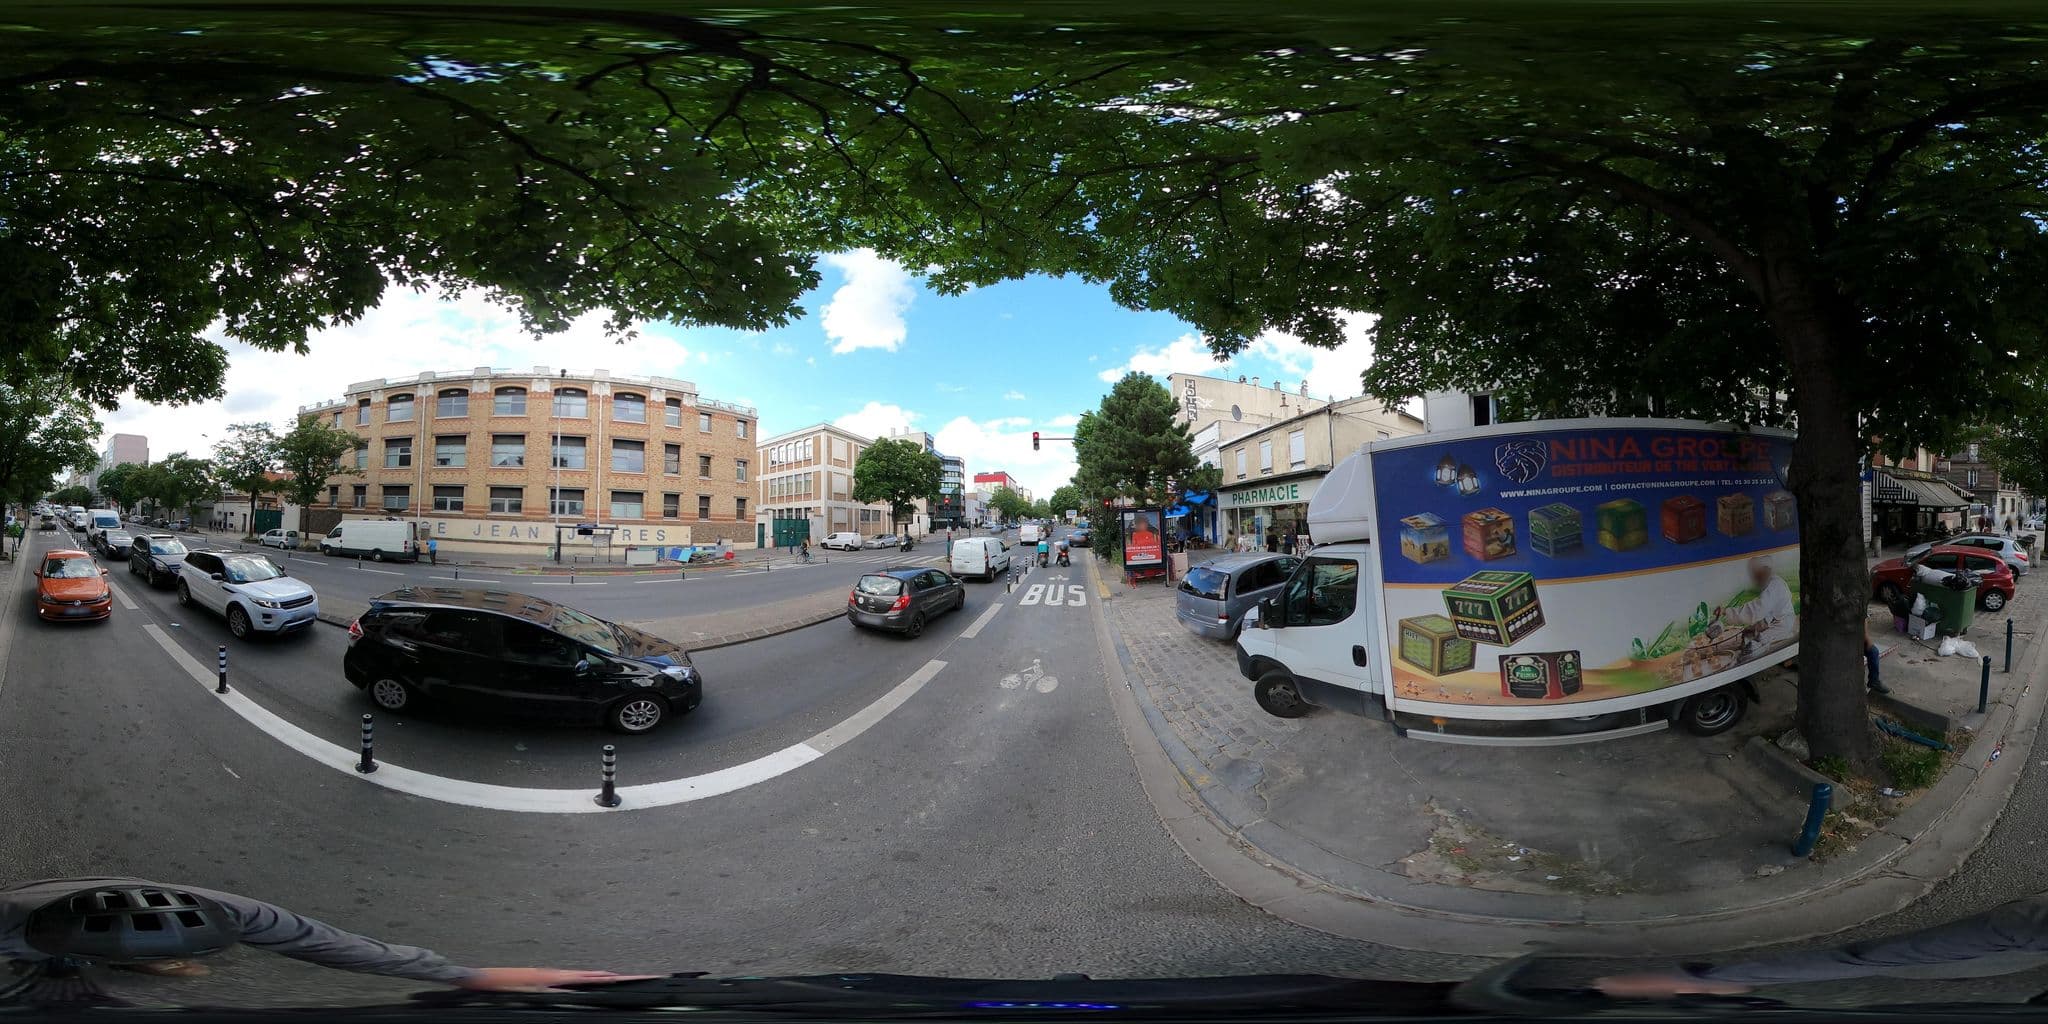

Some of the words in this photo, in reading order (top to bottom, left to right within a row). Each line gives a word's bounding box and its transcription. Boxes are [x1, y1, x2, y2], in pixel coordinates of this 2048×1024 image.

[1551, 437, 1642, 461] NINA
[1232, 484, 1299, 505] PHARMACIE
[1500, 484, 1602, 498] WWW.NINAGROUPE.COM
[1610, 479, 1715, 491] CONTACT@NINAGROUPE.COM
[472, 523, 539, 539] JEAN
[1019, 584, 1087, 606] BUS
[1505, 586, 1530, 611] 777
[1455, 600, 1484, 616] 777
